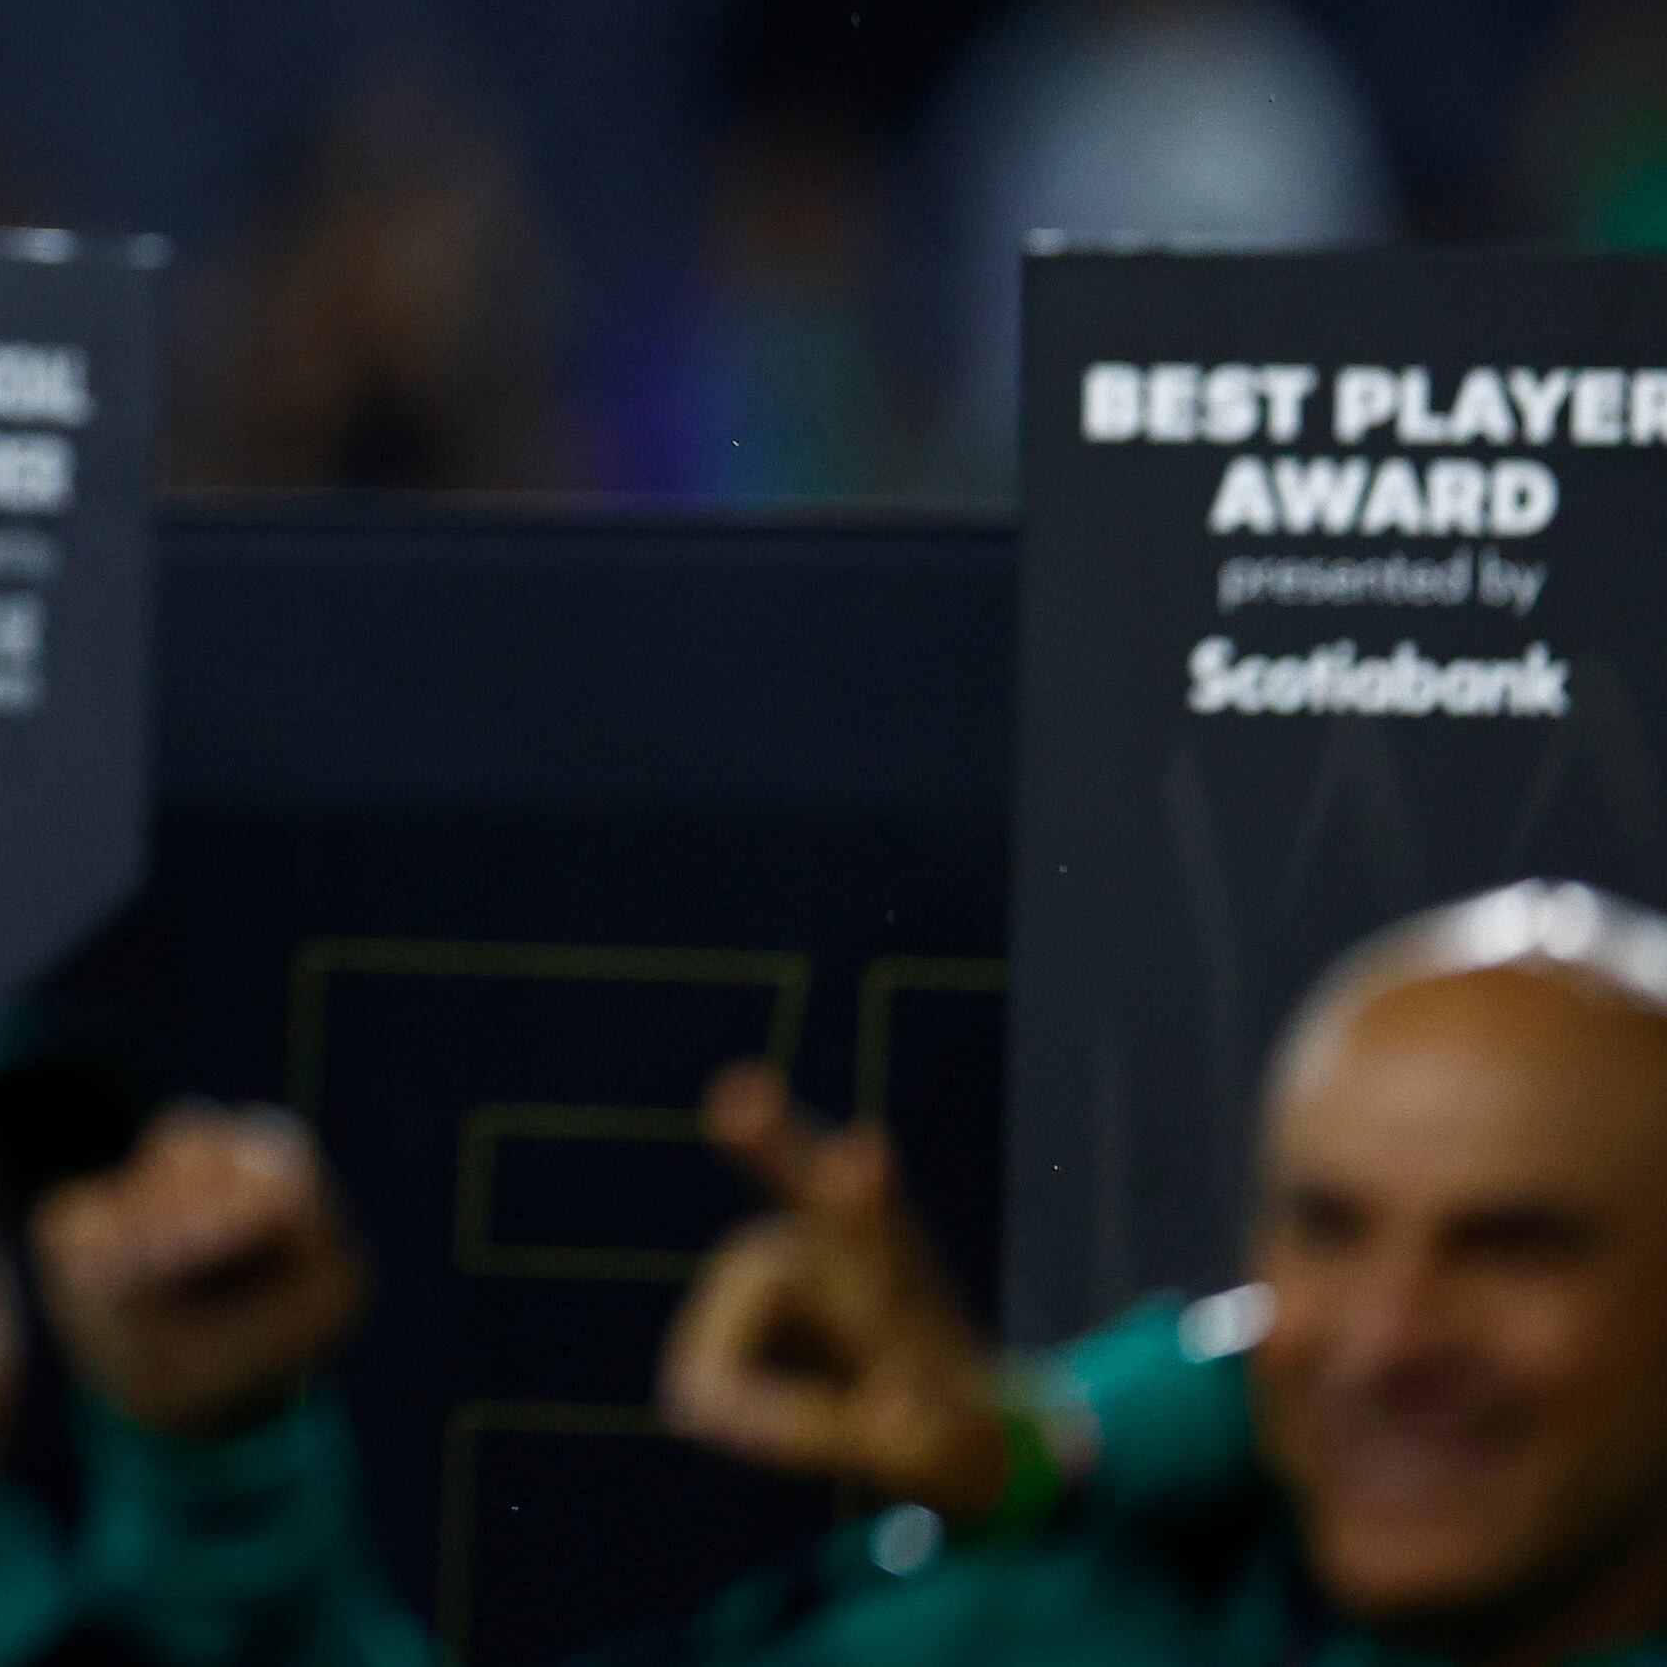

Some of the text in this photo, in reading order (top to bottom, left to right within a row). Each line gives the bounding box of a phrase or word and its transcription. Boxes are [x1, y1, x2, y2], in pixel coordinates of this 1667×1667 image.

[1079, 360, 1318, 444] BEST
[1206, 454, 1561, 538] AWARD
[1215, 547, 1549, 617] presented by
[1186, 635, 1572, 716] Scotiabank
